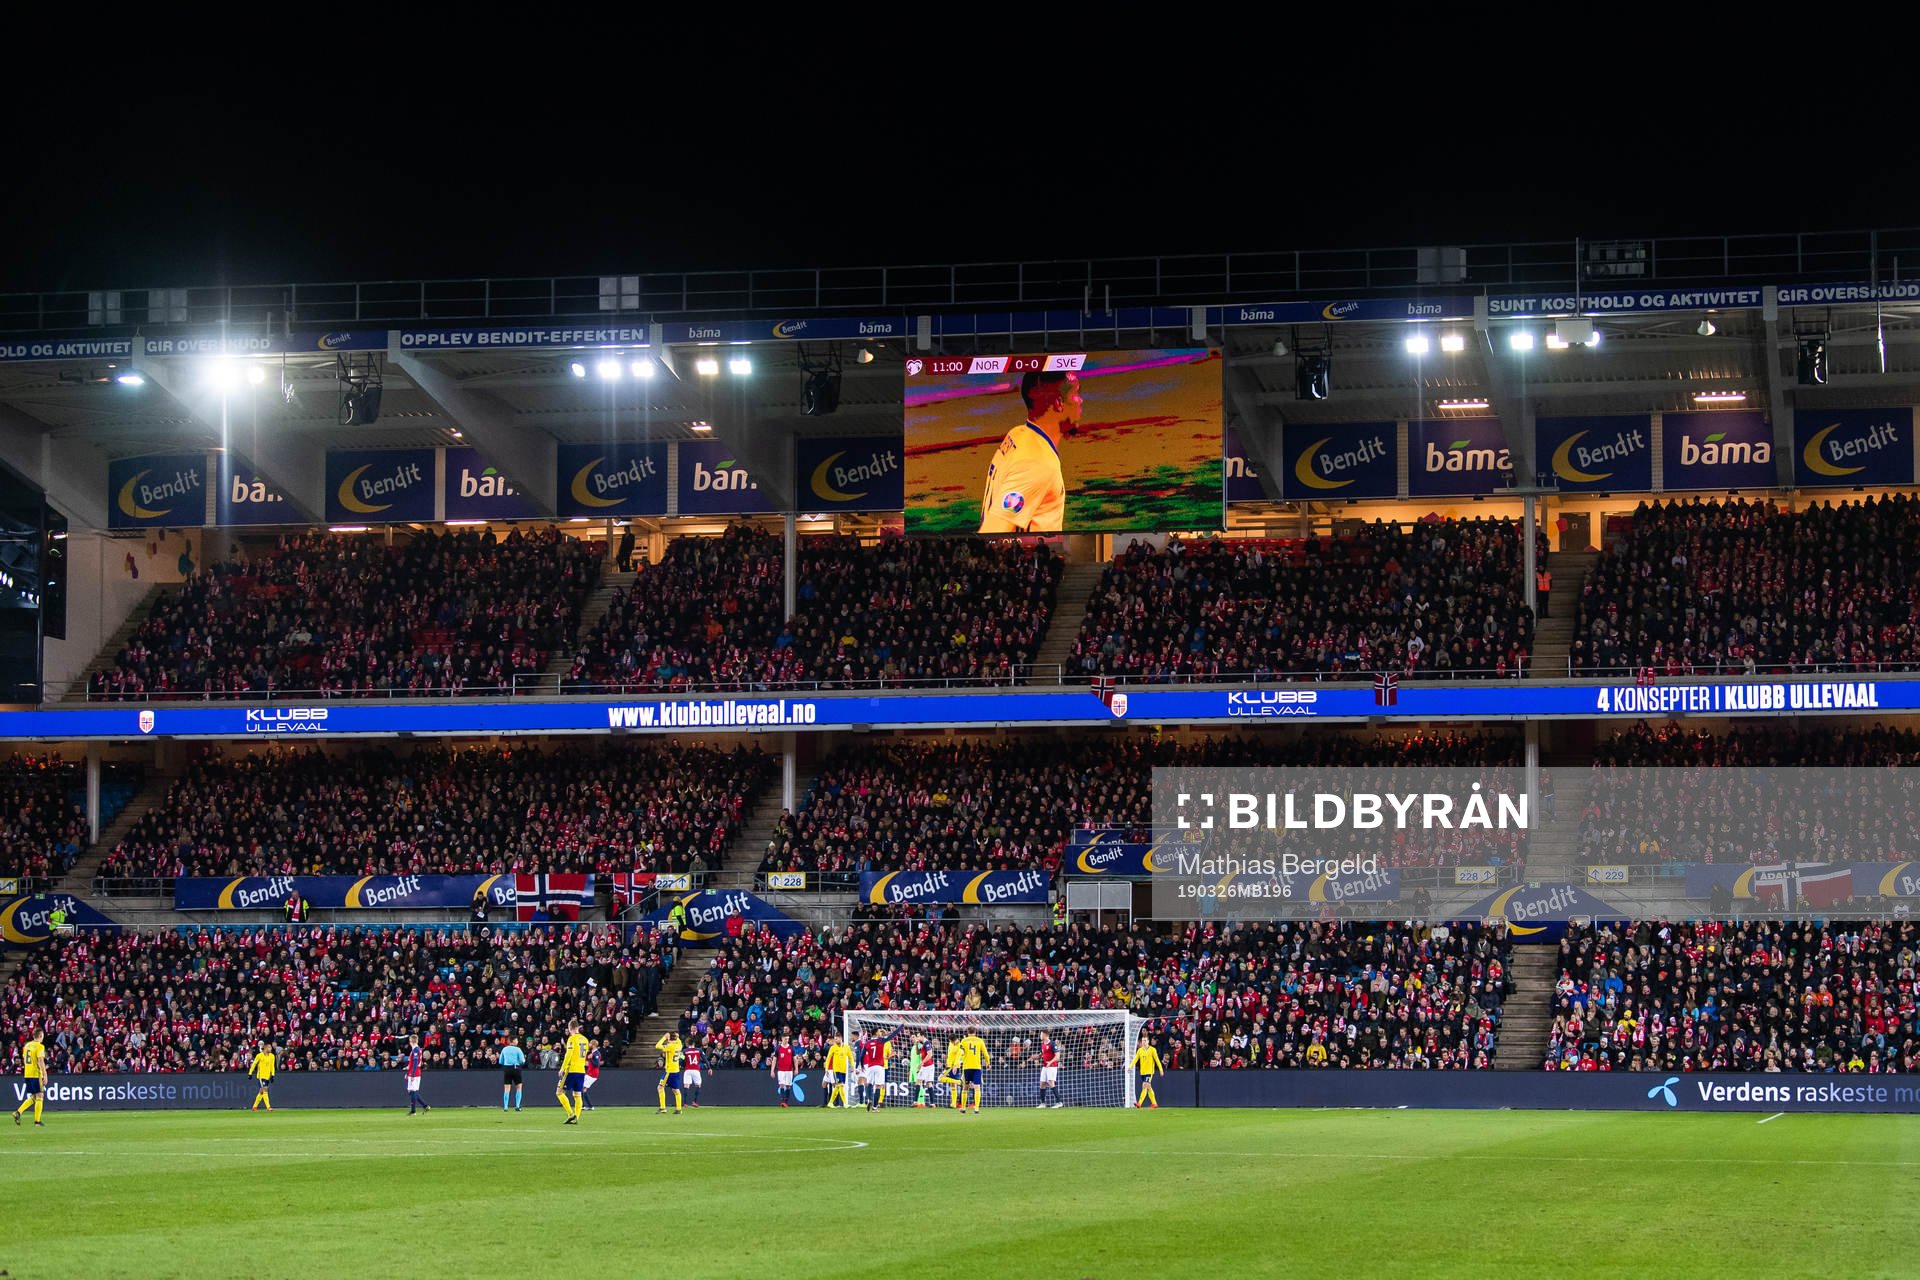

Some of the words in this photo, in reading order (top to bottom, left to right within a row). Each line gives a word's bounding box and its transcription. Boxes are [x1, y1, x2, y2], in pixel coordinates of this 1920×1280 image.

[1490, 299, 1536, 312] SUNT
[1541, 296, 1635, 311] KOSTHOLD
[1640, 294, 1665, 308] OG
[1669, 290, 1760, 306] AKTIVITET
[1777, 289, 1808, 302] GIR
[1811, 285, 1920, 300] OVERSKUDD
[1332, 301, 1359, 316] Bendit
[401, 332, 473, 346] OPPLEV
[477, 328, 644, 344] BENDIT-EFFEKTEN
[782, 320, 808, 334] Bendit
[31, 344, 53, 357] OG
[56, 340, 132, 356] AKTIVITET
[147, 340, 173, 353] GIR
[177, 337, 271, 352] OVERSKUDD
[326, 332, 352, 347] Bendit
[932, 361, 963, 372] 11:00
[975, 360, 1000, 371] NOR
[1056, 358, 1078, 369] SVE
[1577, 429, 1645, 467] Bendit
[1829, 422, 1898, 461] Bendit
[1319, 436, 1387, 475] Bendit
[594, 456, 656, 493] Bendit
[834, 450, 898, 488] Bendit
[140, 468, 199, 505] Bendit
[360, 462, 422, 499] Bendit
[1228, 691, 1317, 704] KLUBB
[1596, 687, 1610, 712] 4
[1614, 686, 1710, 711] KONSEPTER
[1725, 684, 1785, 710] KLUBB
[1791, 683, 1878, 708] ULLEVAAL
[246, 708, 328, 721] KLUBB
[608, 700, 816, 727] www.klubbullevaal.no
[1228, 706, 1317, 716] ULLEVAAL
[246, 723, 328, 732] ULLEVAAL
[1089, 846, 1123, 866] Bendit
[1155, 846, 1189, 865] Bendit
[656, 879, 674, 889] 227
[783, 877, 802, 887] 228
[1331, 867, 1392, 900] Bendit
[1460, 872, 1478, 882] 228
[1605, 871, 1624, 880] 229
[239, 876, 293, 908] Bendit
[365, 875, 421, 907] Bendit
[892, 870, 949, 903] Bendit
[984, 870, 1043, 903] Bendit
[690, 892, 751, 927] Bendit
[1512, 885, 1578, 921] Bendit
[688, 1054, 699, 1066] 14
[870, 1045, 877, 1059] 7
[99, 1081, 177, 1101] raskeste
[1698, 1082, 1791, 1102] Verdens
[1797, 1082, 1887, 1103] raskeste
